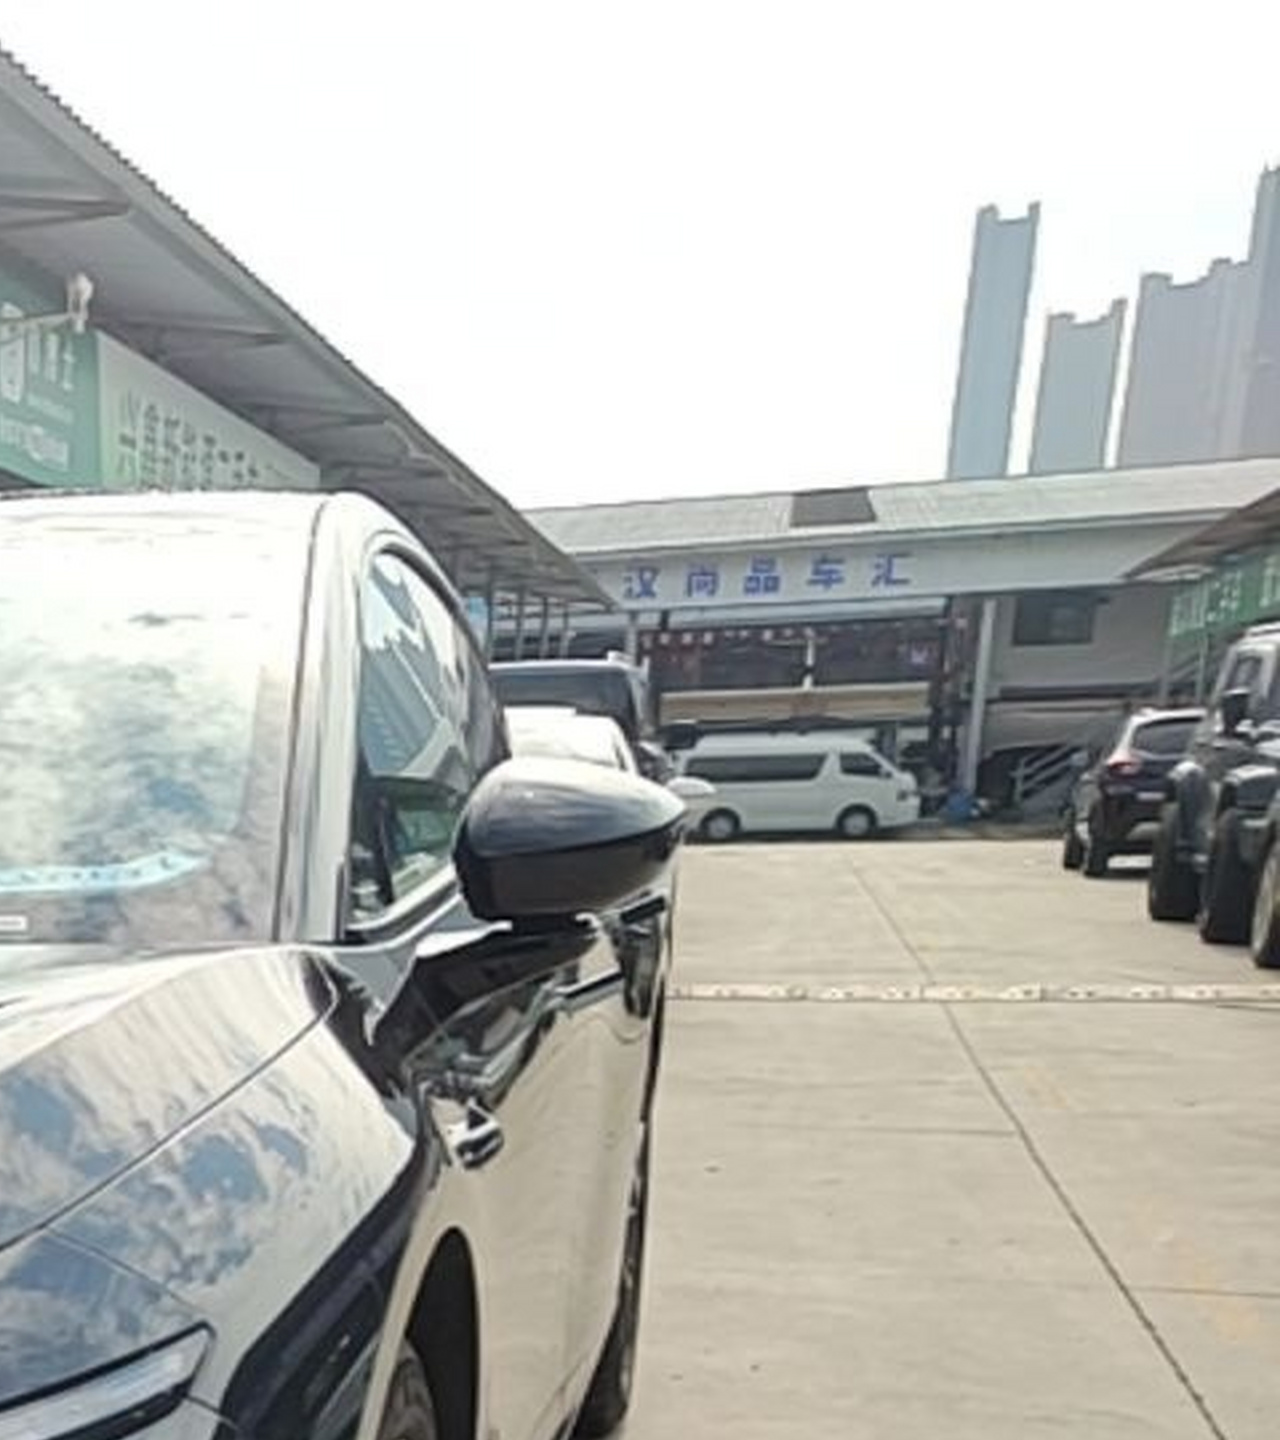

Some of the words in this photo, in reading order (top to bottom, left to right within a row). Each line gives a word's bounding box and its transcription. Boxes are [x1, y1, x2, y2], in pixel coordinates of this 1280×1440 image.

[623, 553, 910, 599] 汉尚品车汇
